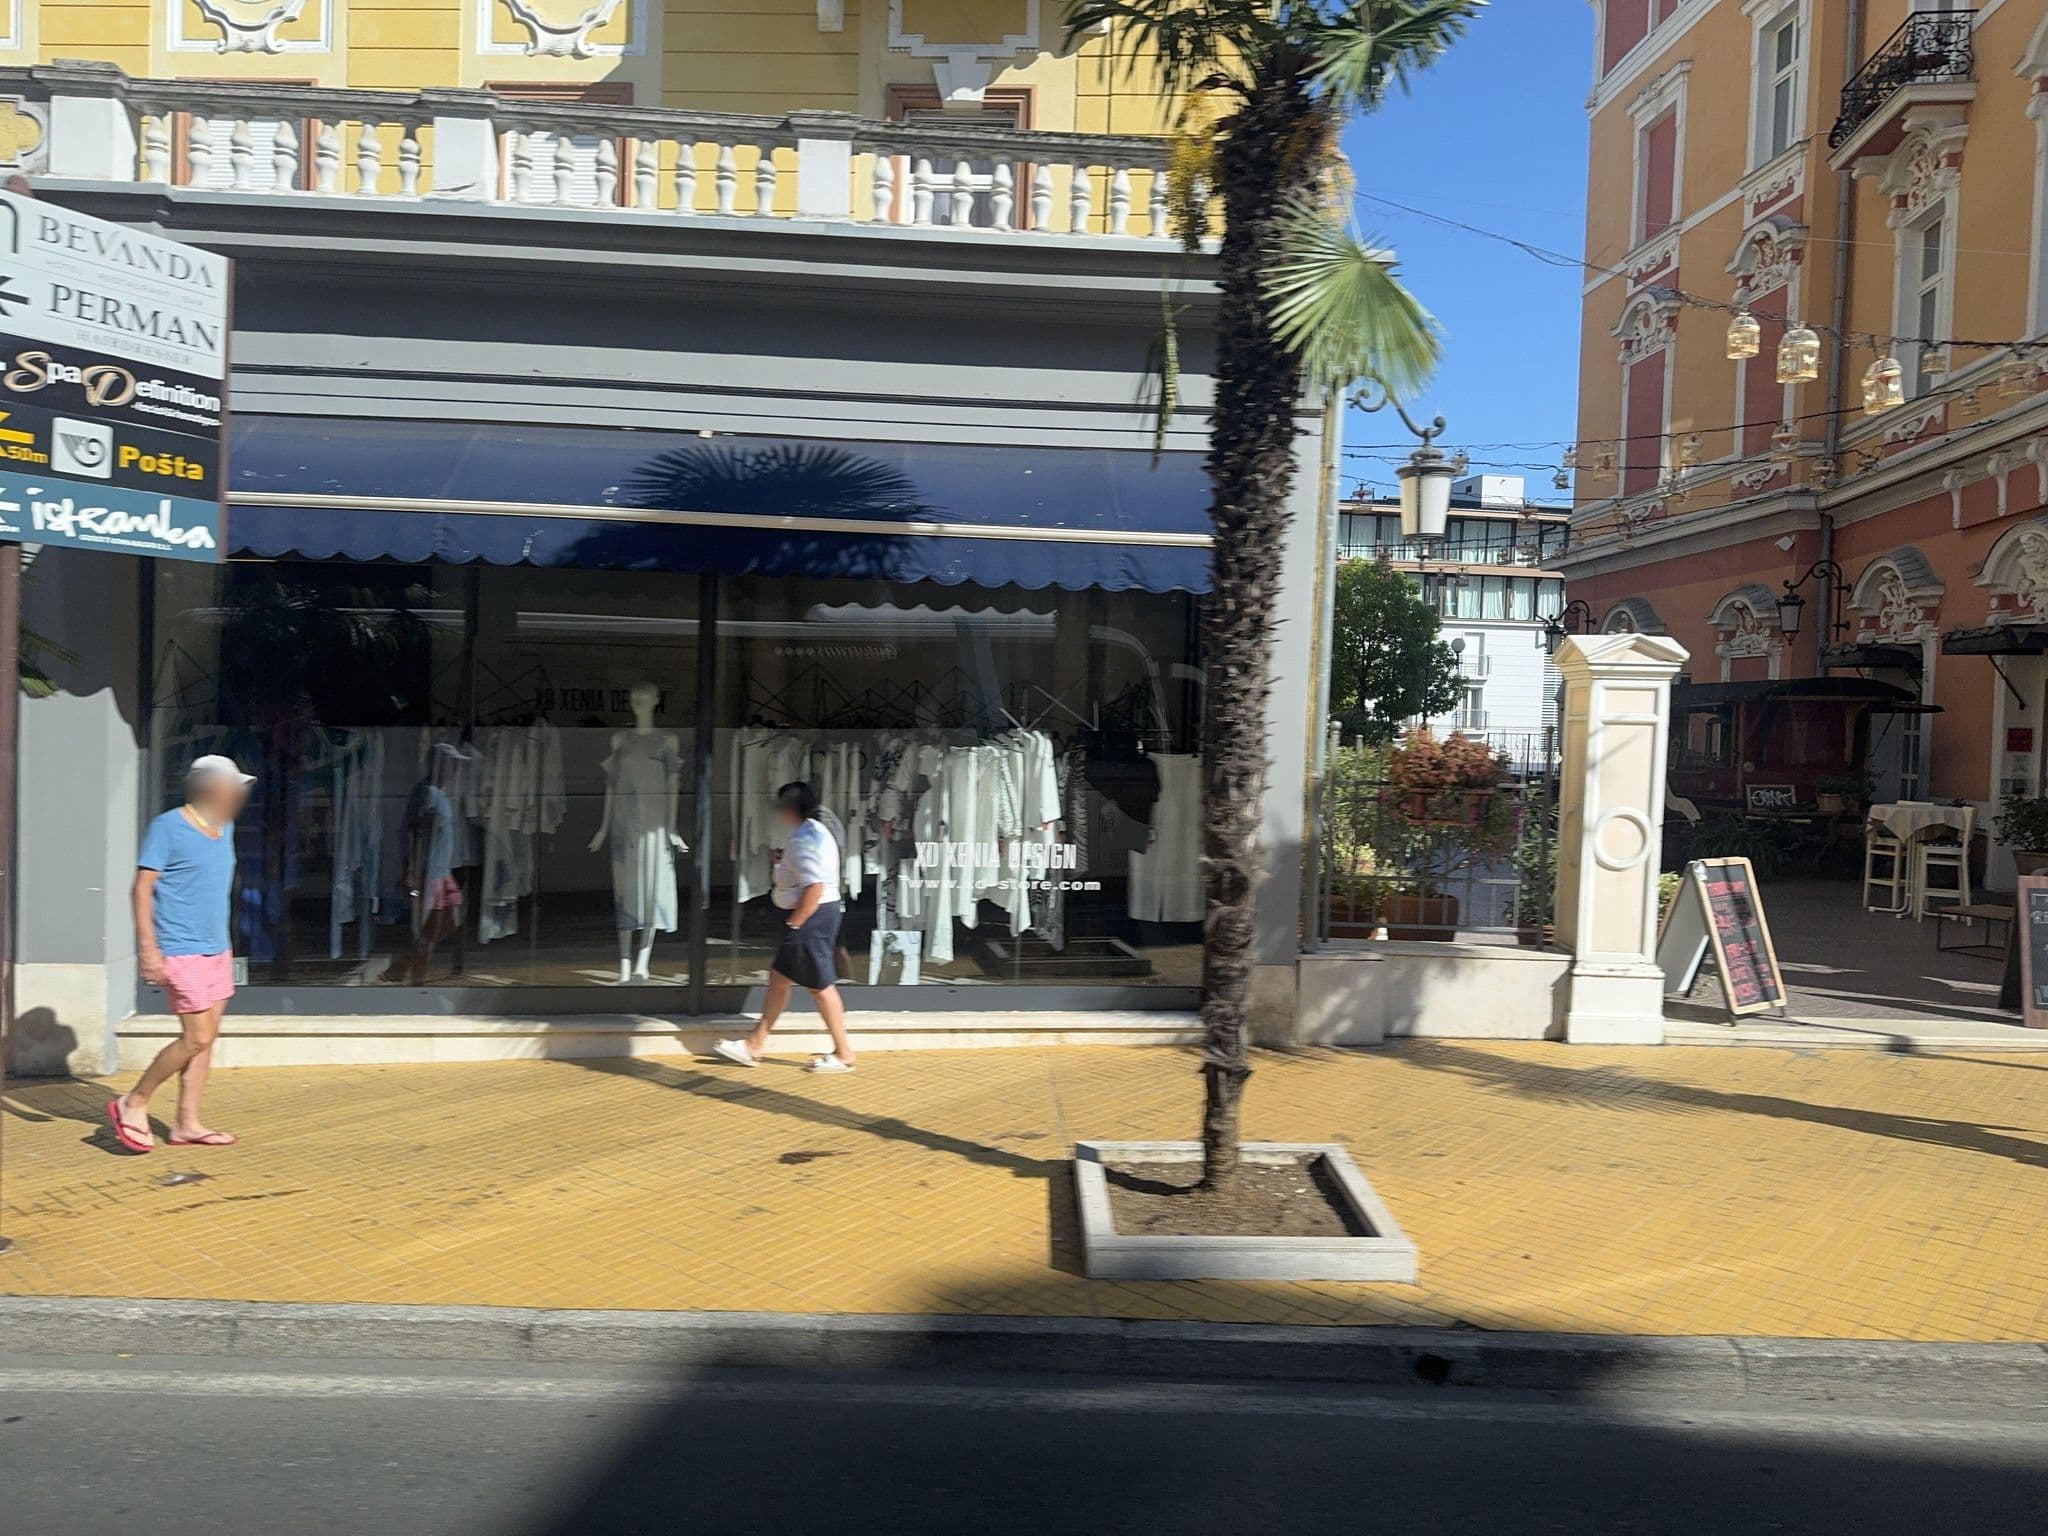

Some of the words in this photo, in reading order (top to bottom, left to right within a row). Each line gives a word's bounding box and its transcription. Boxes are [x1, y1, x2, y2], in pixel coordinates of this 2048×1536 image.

[36, 215, 214, 289] BEVANDA
[48, 282, 219, 352] PERMAN
[4, 351, 82, 393] Spa
[118, 445, 204, 481] Pošta
[560, 688, 604, 712] XENIA
[944, 842, 1000, 868] XENIA
[1008, 842, 1077, 869] DESIGN
